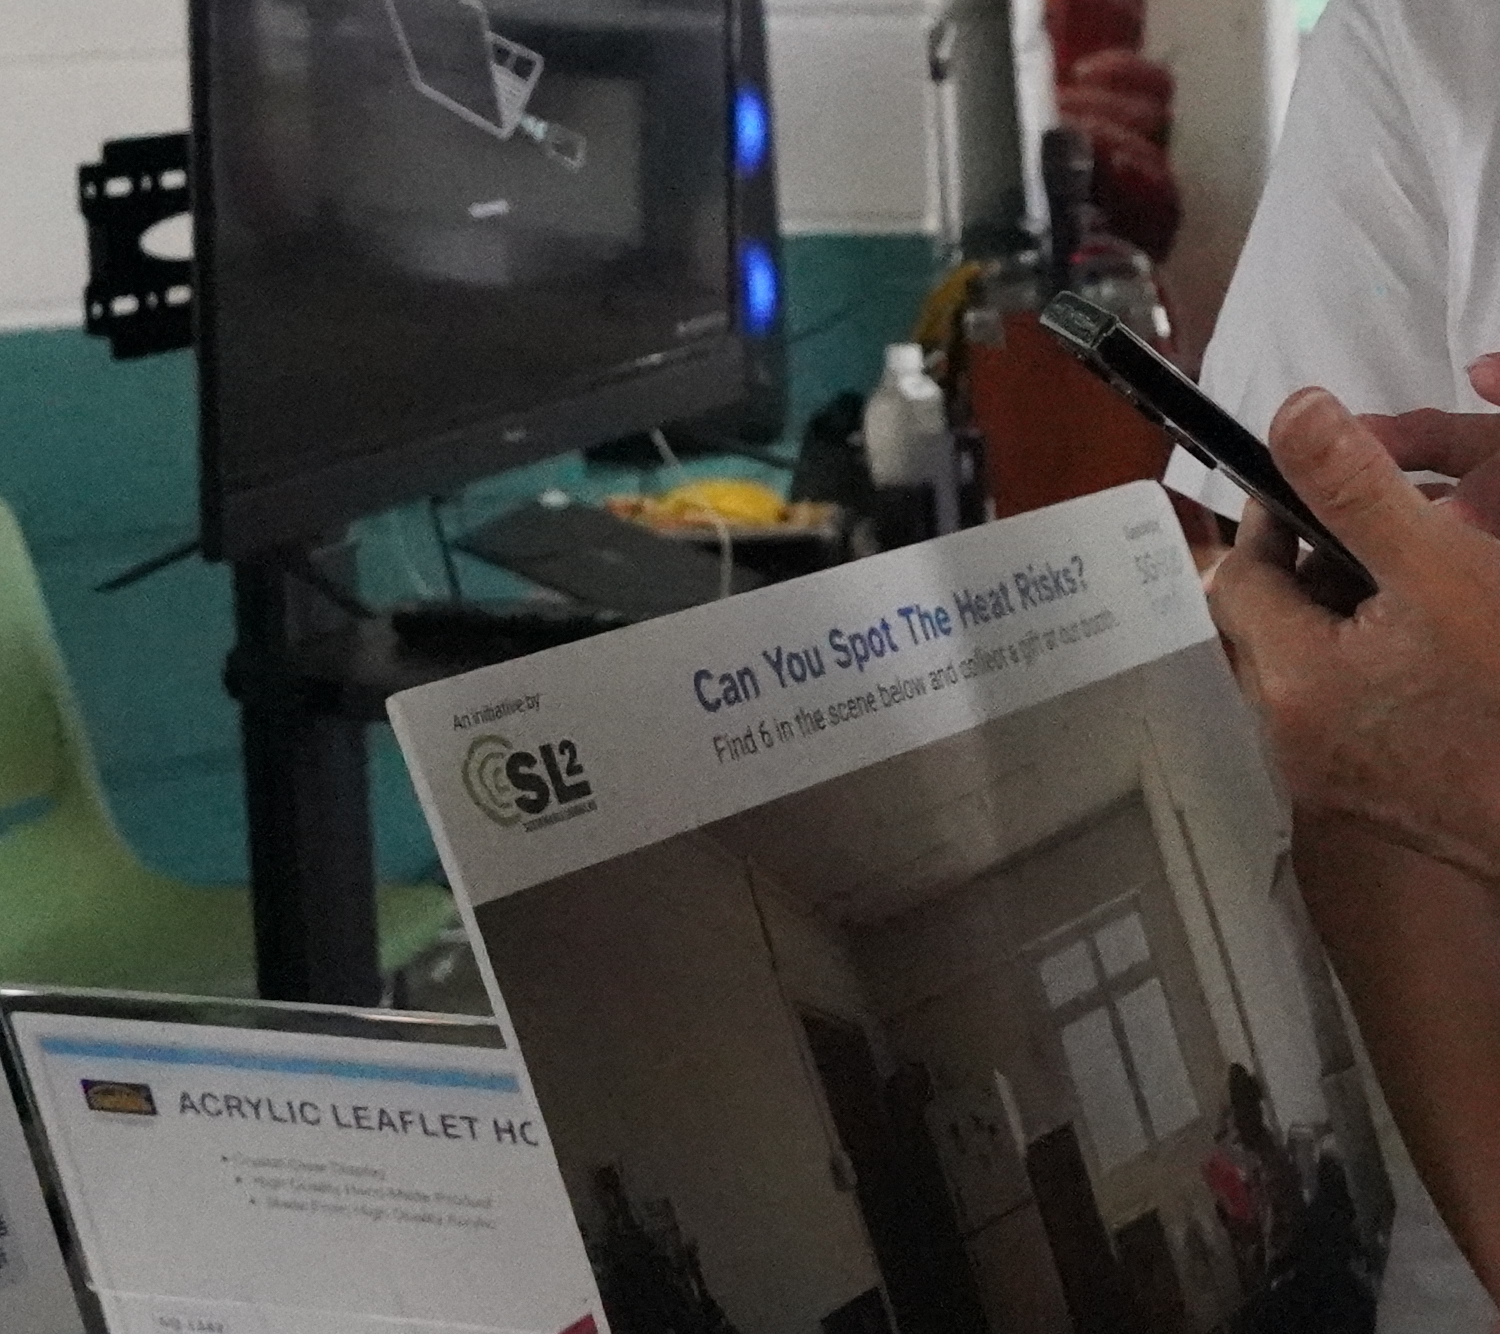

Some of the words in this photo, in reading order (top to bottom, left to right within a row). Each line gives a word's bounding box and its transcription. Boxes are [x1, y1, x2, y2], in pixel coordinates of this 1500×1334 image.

[692, 657, 762, 715] Can
[763, 639, 826, 693] You
[827, 624, 899, 686] Spot
[898, 598, 954, 647] The
[953, 578, 1015, 631] Heat
[1016, 554, 1090, 615] Risks?
[452, 709, 470, 733] An
[472, 697, 525, 726] initiative
[526, 691, 544, 717] by
[712, 723, 759, 765] Find
[760, 716, 777, 749] 6
[779, 712, 798, 742] in
[799, 703, 828, 736] the
[829, 692, 878, 728] scene
[878, 675, 929, 714] below
[930, 661, 960, 701] and
[178, 1089, 321, 1128] ACRYLIC
[331, 1103, 476, 1143] LEAFLET
